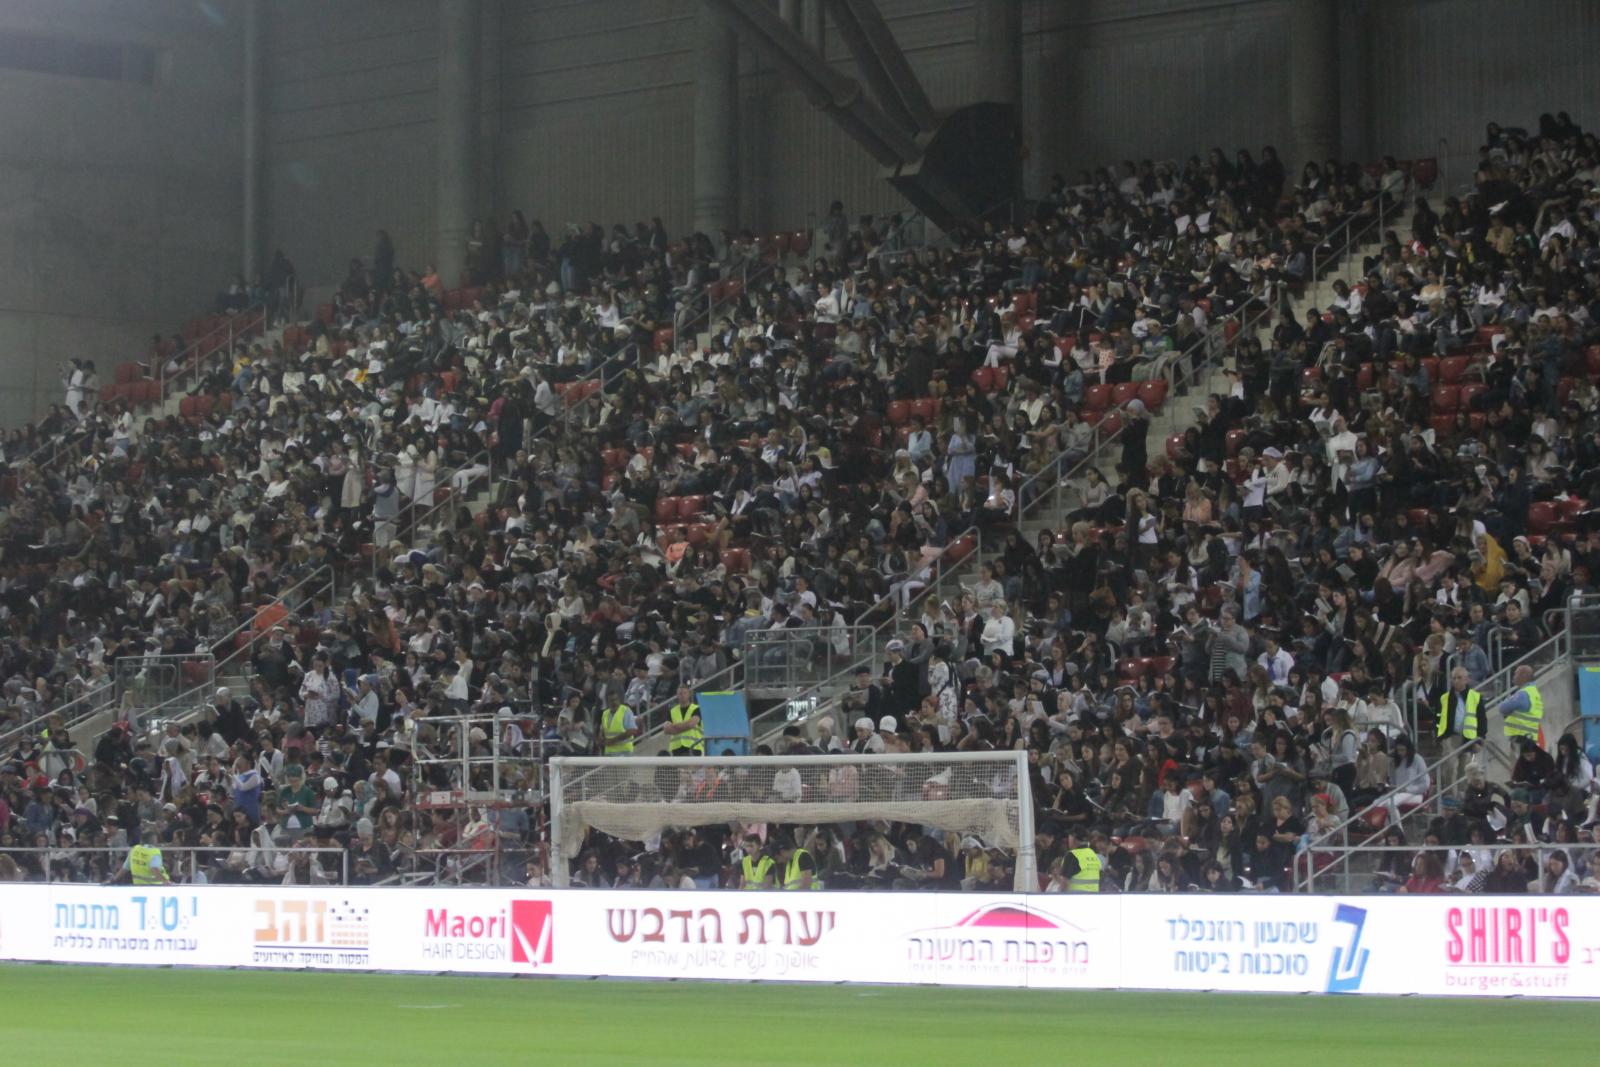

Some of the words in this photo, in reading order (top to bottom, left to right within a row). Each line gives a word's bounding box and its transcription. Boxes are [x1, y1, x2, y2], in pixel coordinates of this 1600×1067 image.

[55, 903, 119, 930] מתכות
[254, 899, 327, 943] זהב
[425, 908, 506, 939] Maori
[606, 907, 723, 944] הדבש
[738, 907, 837, 947] יערת
[1166, 915, 1245, 943] רוזנפלד
[1254, 921, 1318, 948] שמעון
[1447, 907, 1570, 964] SHIRI'S
[422, 943, 453, 960] HAIR
[456, 943, 506, 961] DESIGN
[908, 937, 994, 962] המשנה
[1005, 939, 1089, 964] מרכבת
[1174, 950, 1231, 974] ביטוח
[1240, 952, 1309, 976] סוכנות
